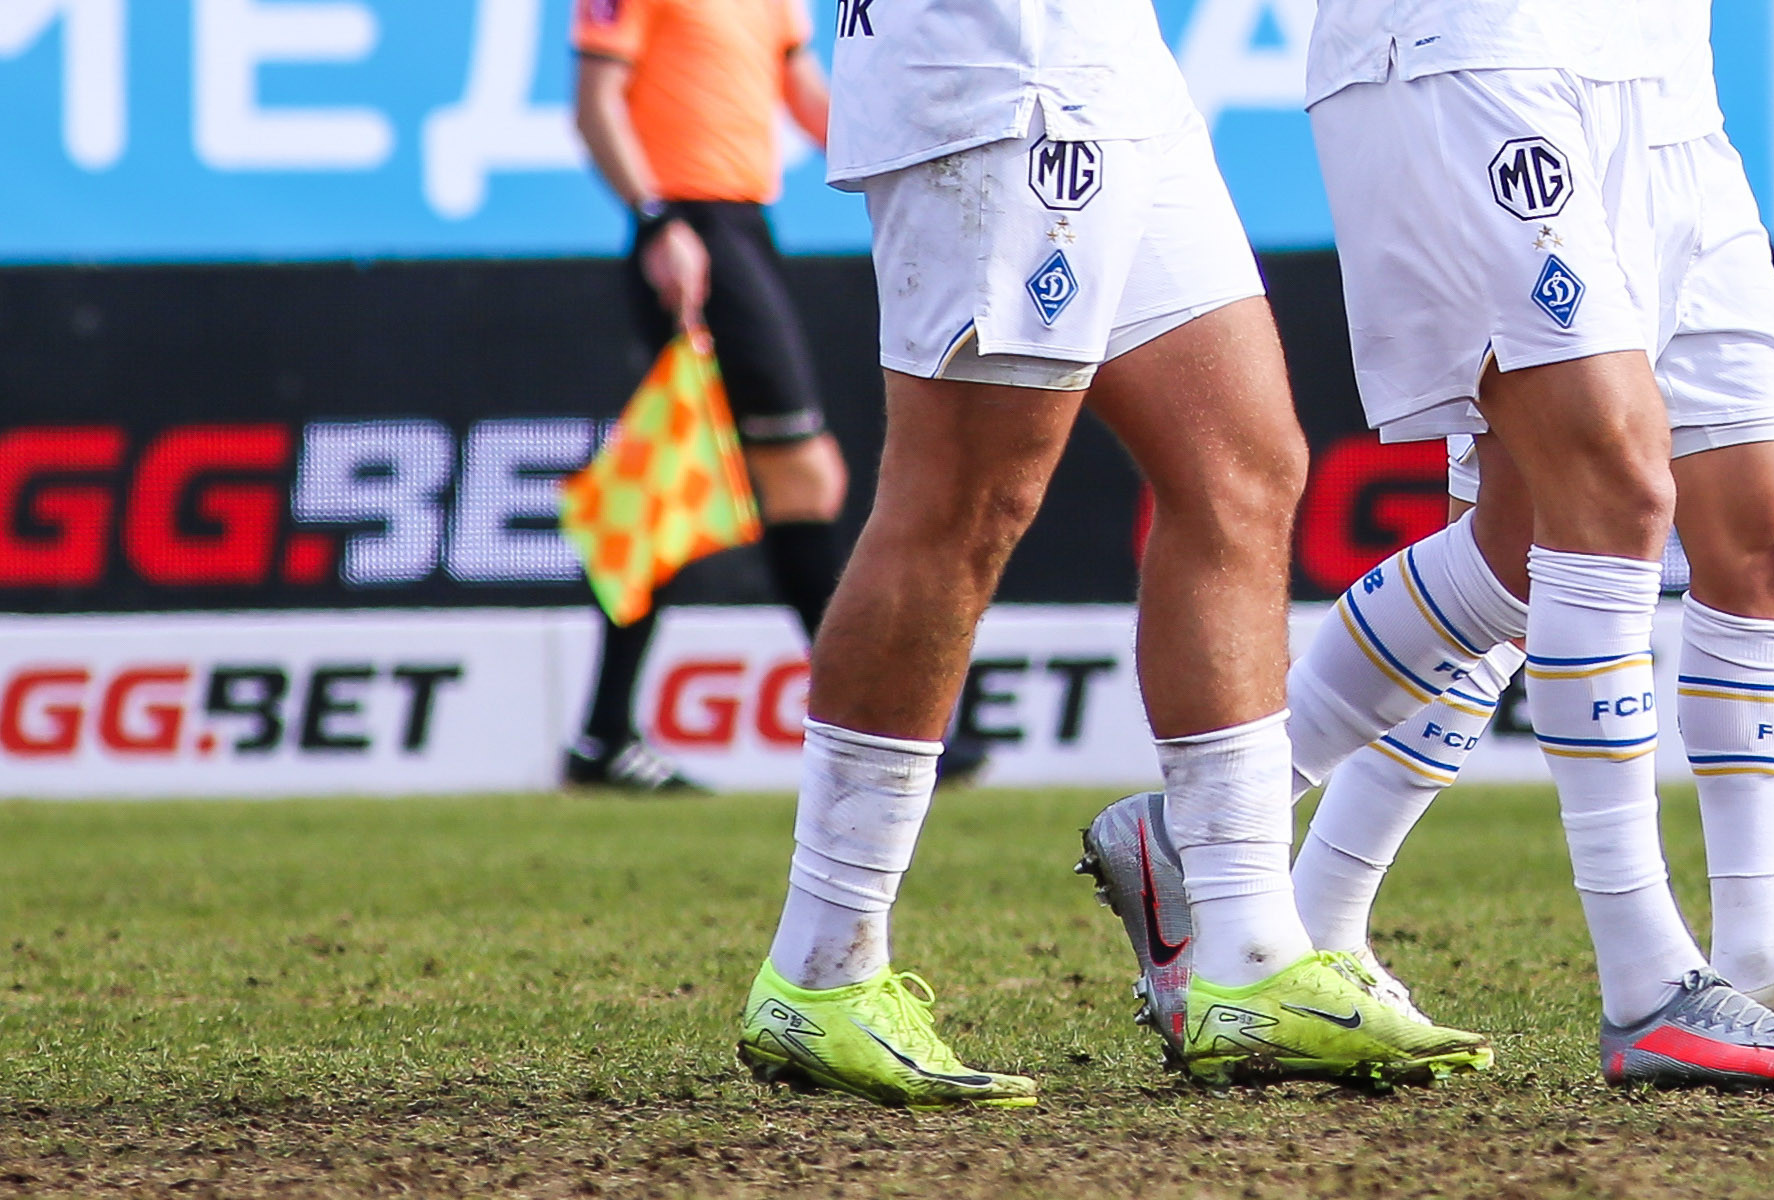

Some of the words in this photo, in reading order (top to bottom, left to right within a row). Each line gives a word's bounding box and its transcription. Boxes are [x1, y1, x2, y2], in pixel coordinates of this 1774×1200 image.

[1036, 140, 1096, 201] MG
[1498, 145, 1565, 211] MG
[0, 417, 620, 588] GG.BE
[0, 664, 465, 759] GG.BET
